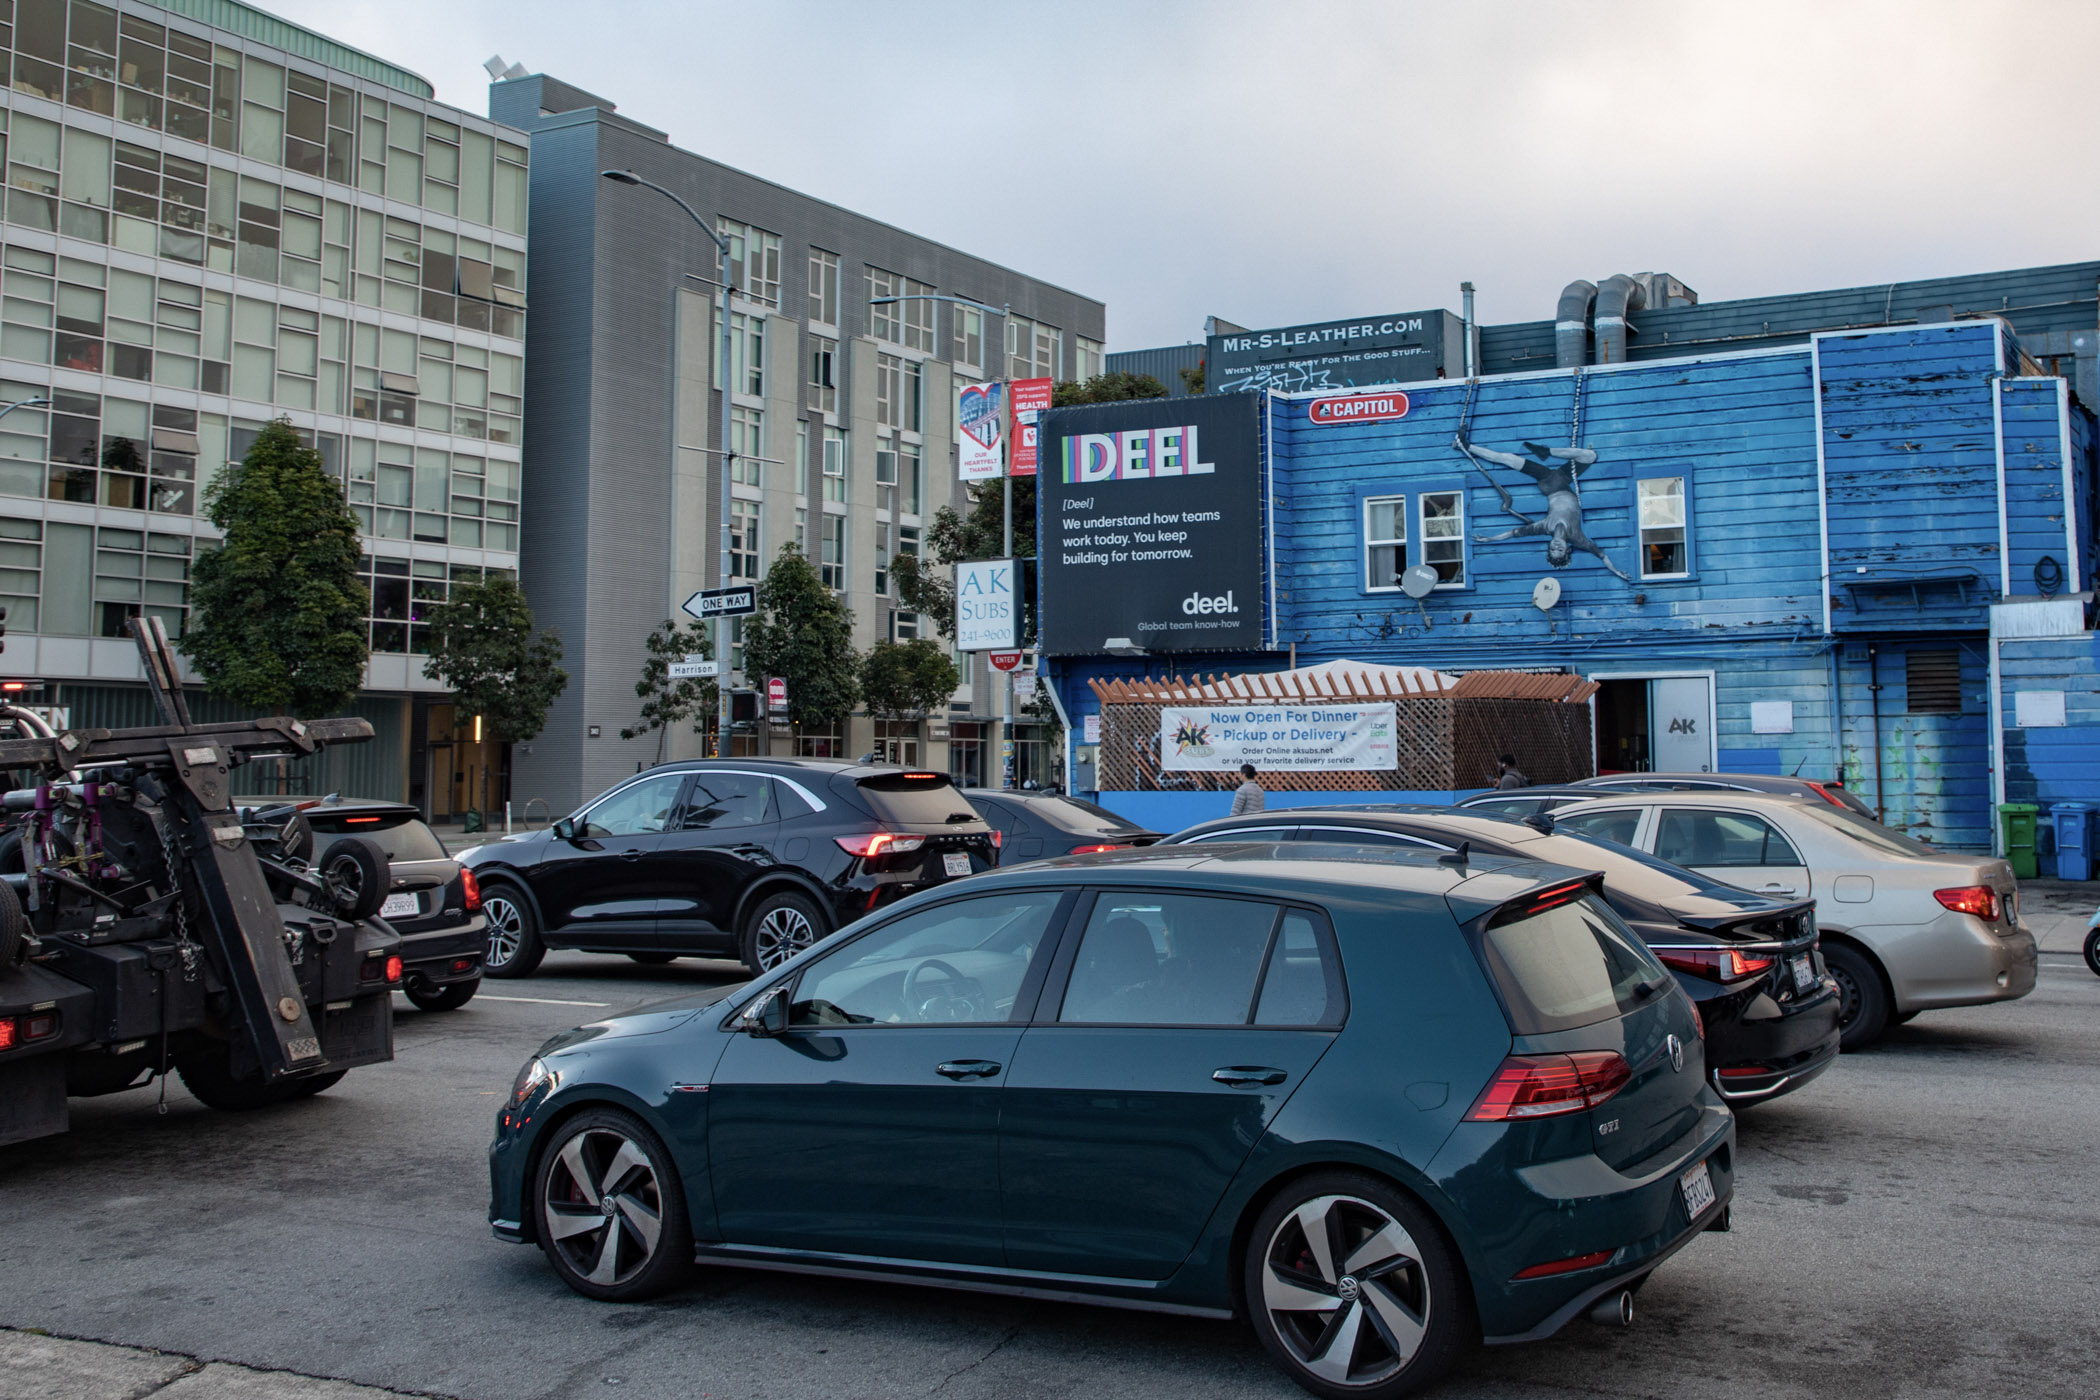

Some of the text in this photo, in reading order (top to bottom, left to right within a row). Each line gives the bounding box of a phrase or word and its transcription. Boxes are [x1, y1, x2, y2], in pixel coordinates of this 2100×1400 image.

[1223, 318, 1423, 352] MR-S-LEATHER.COM
[1224, 366, 1251, 376] WHEN
[1254, 361, 1286, 372] YOU'RE
[1289, 358, 1319, 369] READY
[1322, 356, 1340, 365] FOR
[1342, 354, 1361, 363] THE
[1363, 351, 1389, 360] GOOD
[1015, 401, 1048, 410] HEALTH
[1333, 399, 1398, 417] CAPITOL
[1074, 425, 1215, 484] DEEL
[1062, 497, 1094, 512] [Deel]
[1063, 510, 1221, 530] We understand how teams
[1063, 528, 1188, 548] work today. You keep
[1063, 548, 1193, 566] building for tomorrow.
[703, 595, 747, 610] ONE WAY
[961, 600, 1009, 621] SUBS
[1182, 590, 1239, 615] deel.
[1137, 619, 1240, 632] Global team know-how
[960, 628, 1011, 642] 241-9600
[995, 656, 1016, 664] ENTER
[674, 665, 713, 675] Harrison
[1210, 710, 1358, 725] Now Open For Dinner
[1668, 717, 1696, 735] AK
[1175, 725, 1207, 747] AK
[1223, 729, 1267, 743] Pickup
[1272, 731, 1286, 741] or
[1290, 728, 1347, 741] Delivery
[1241, 746, 1334, 755] Order Online aksubs.net
[1231, 757, 1243, 765] via
[1244, 758, 1261, 766] your
[1263, 756, 1293, 764] favorite
[1294, 756, 1325, 766] delivery
[1327, 756, 1355, 764] service
[1598, 1119, 1620, 1136] GTI
